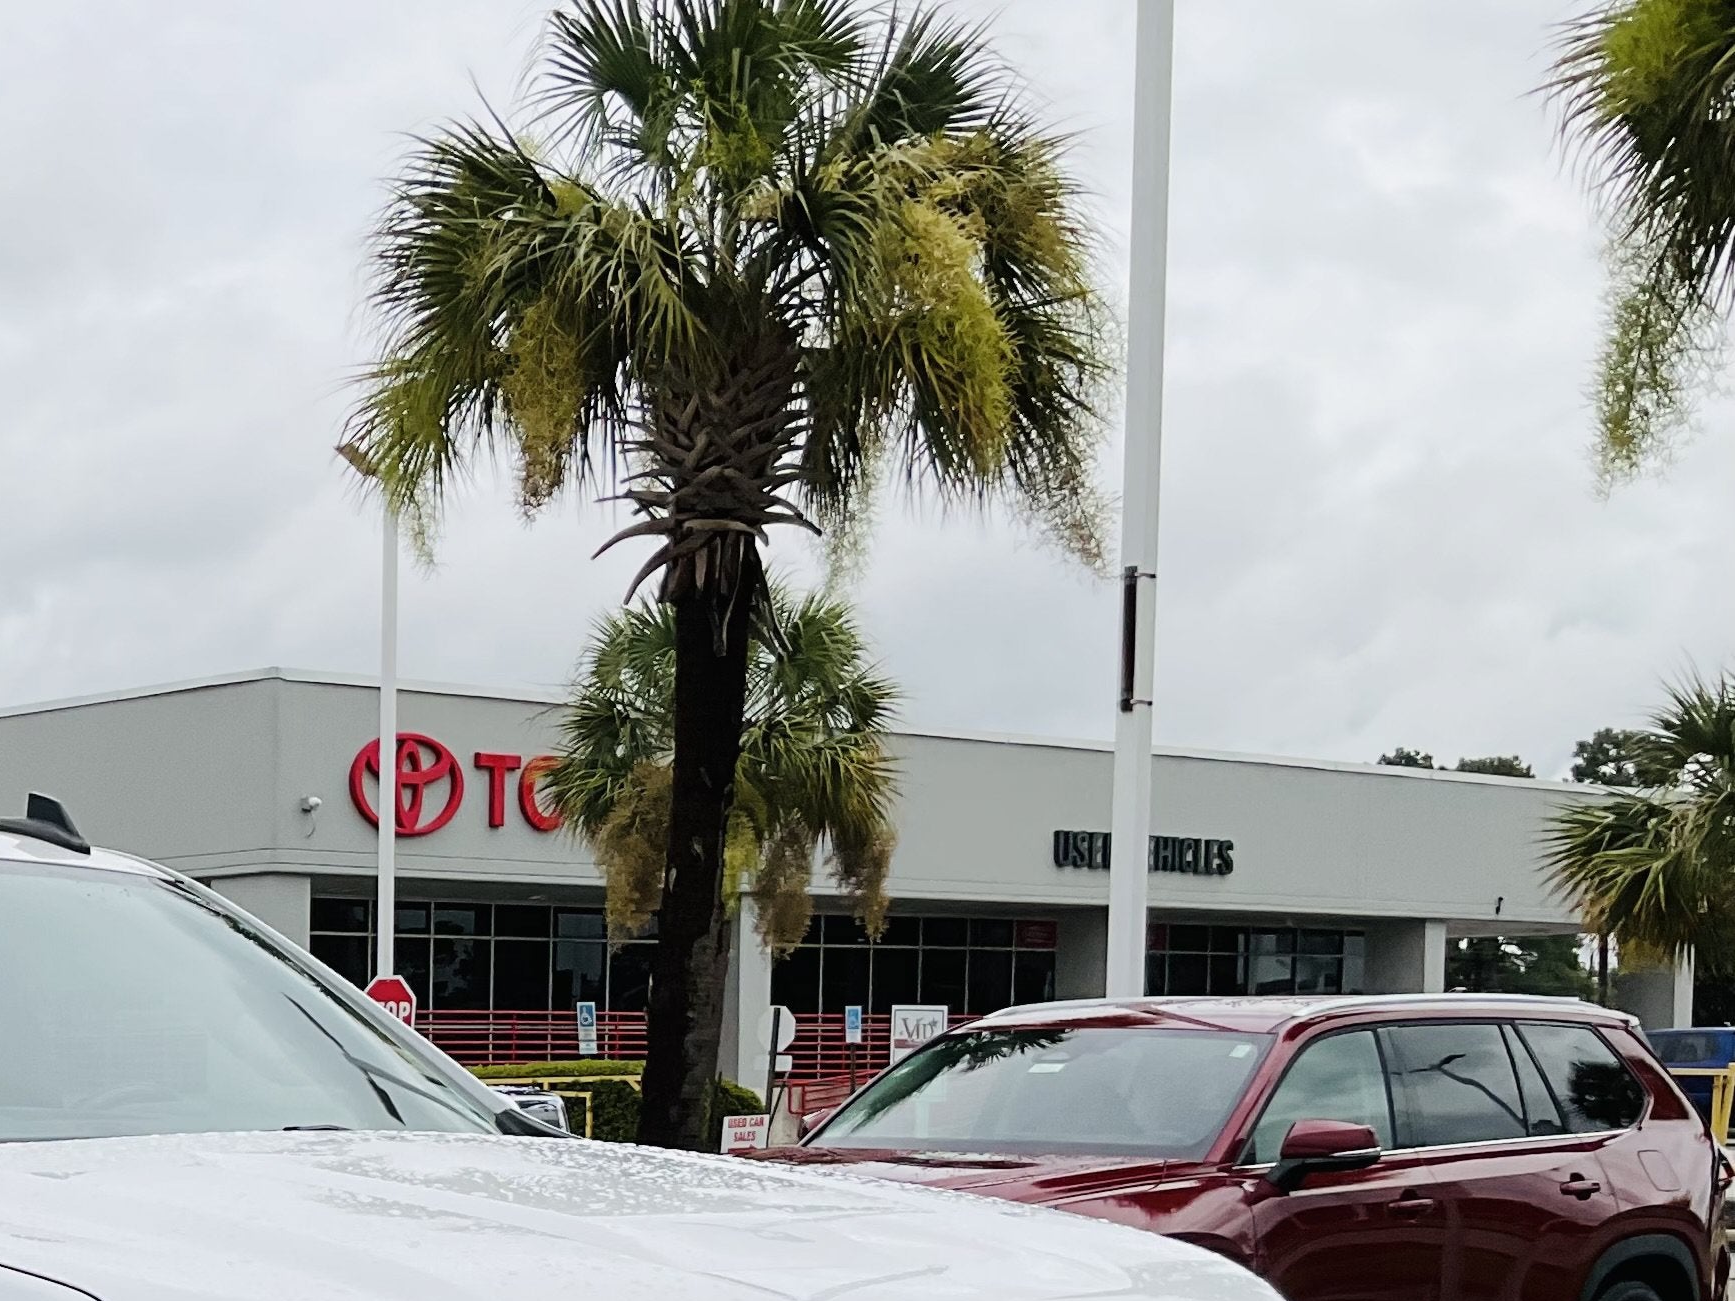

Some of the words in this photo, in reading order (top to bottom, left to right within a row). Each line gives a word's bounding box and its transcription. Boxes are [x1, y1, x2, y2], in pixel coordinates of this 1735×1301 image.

[1053, 830, 1112, 869] USE
[1148, 835, 1234, 876] HICLES
[377, 1001, 411, 1021] OP
[734, 1130, 756, 1142] SALES
